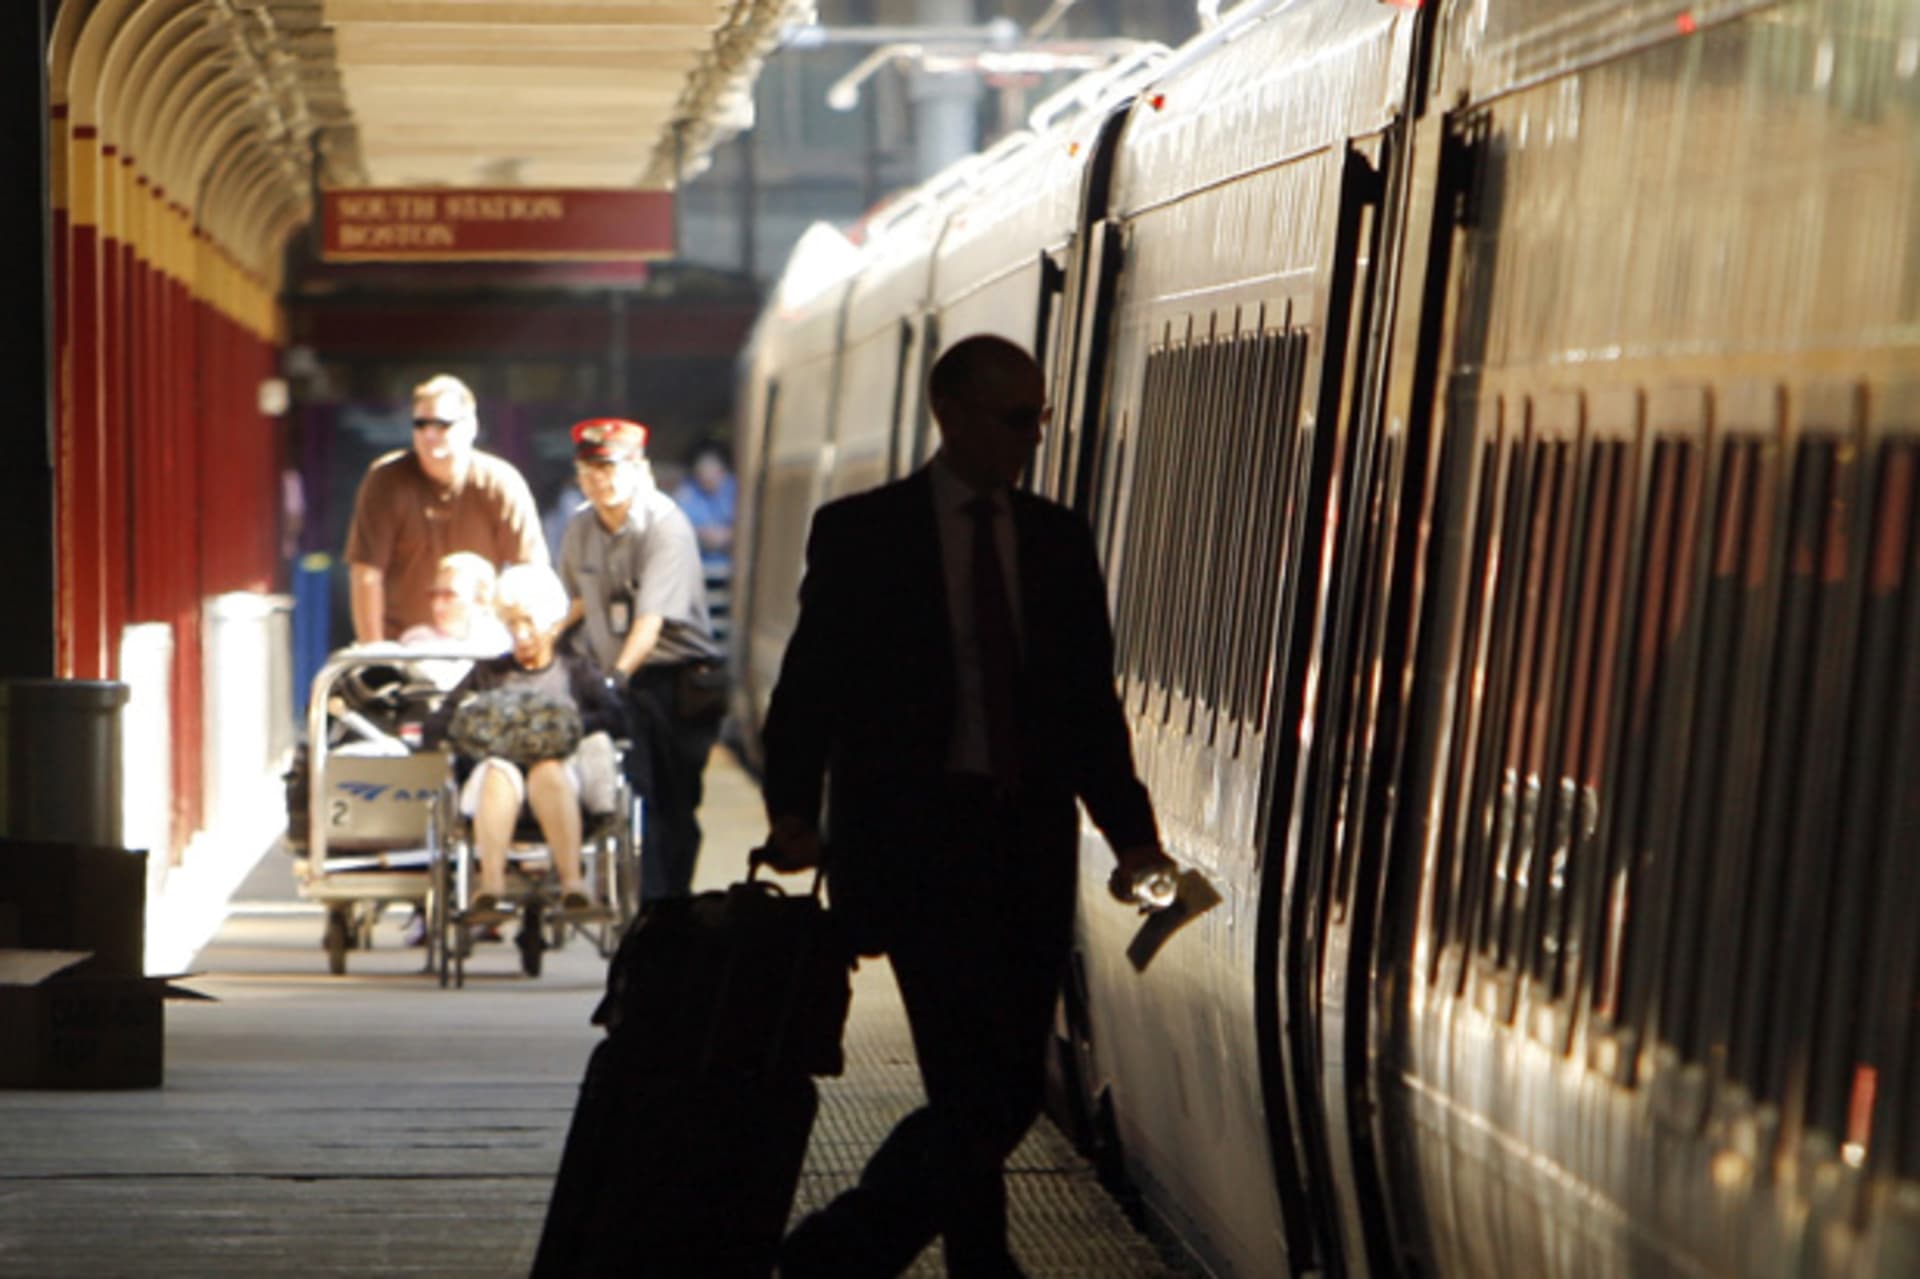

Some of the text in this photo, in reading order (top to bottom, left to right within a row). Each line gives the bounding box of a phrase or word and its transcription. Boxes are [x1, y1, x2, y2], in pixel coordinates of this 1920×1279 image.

[338, 196, 563, 219] SOUTH STATION
[338, 225, 454, 246] BOSTON
[332, 801, 347, 826] 2
